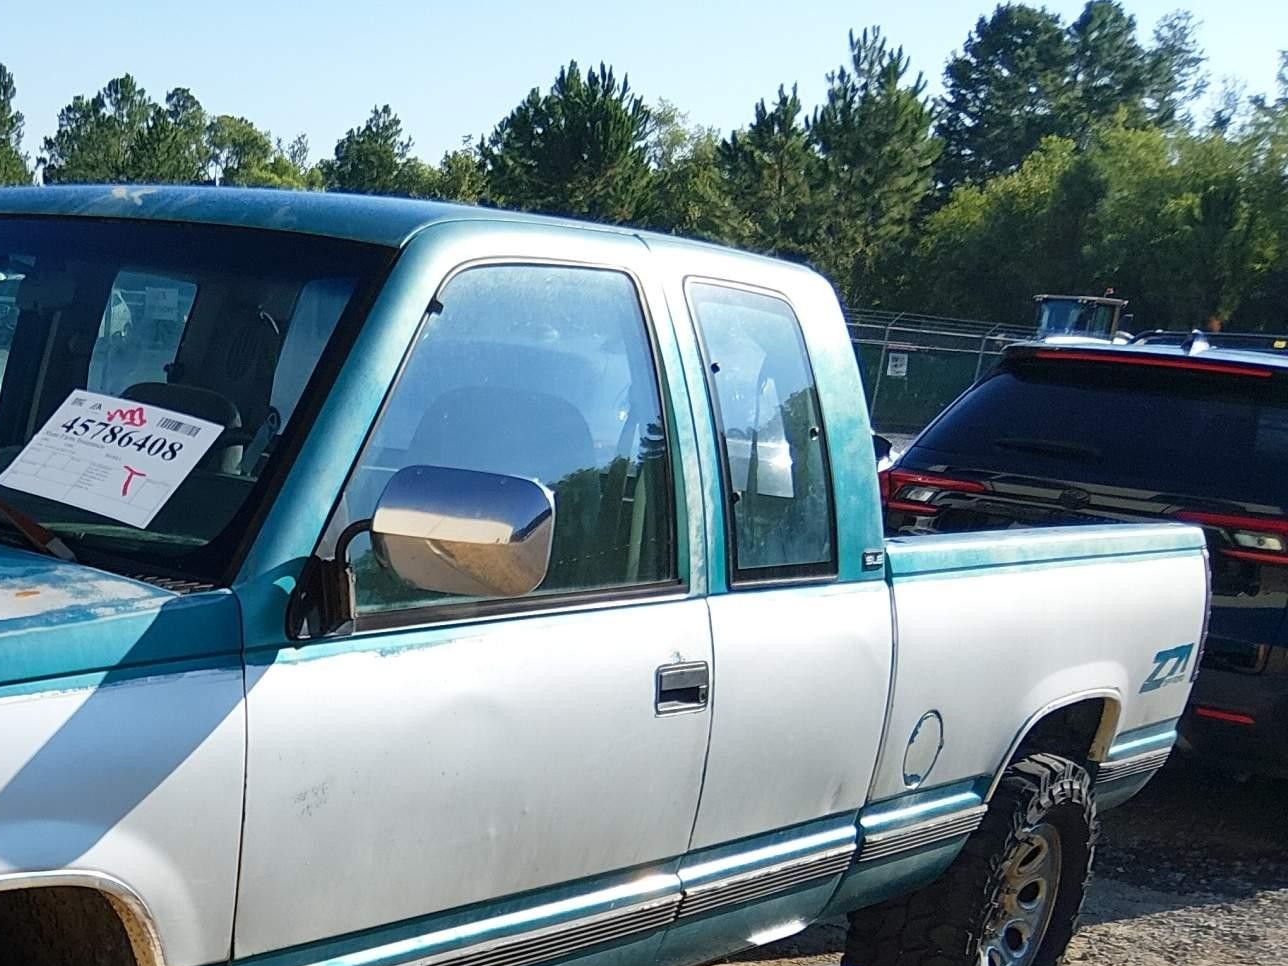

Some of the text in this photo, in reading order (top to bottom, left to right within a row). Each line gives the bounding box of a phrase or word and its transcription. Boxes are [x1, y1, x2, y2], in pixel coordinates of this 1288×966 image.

[62, 416, 184, 462] 45786408
[123, 465, 147, 497] T
[1138, 642, 1195, 695] Z71
